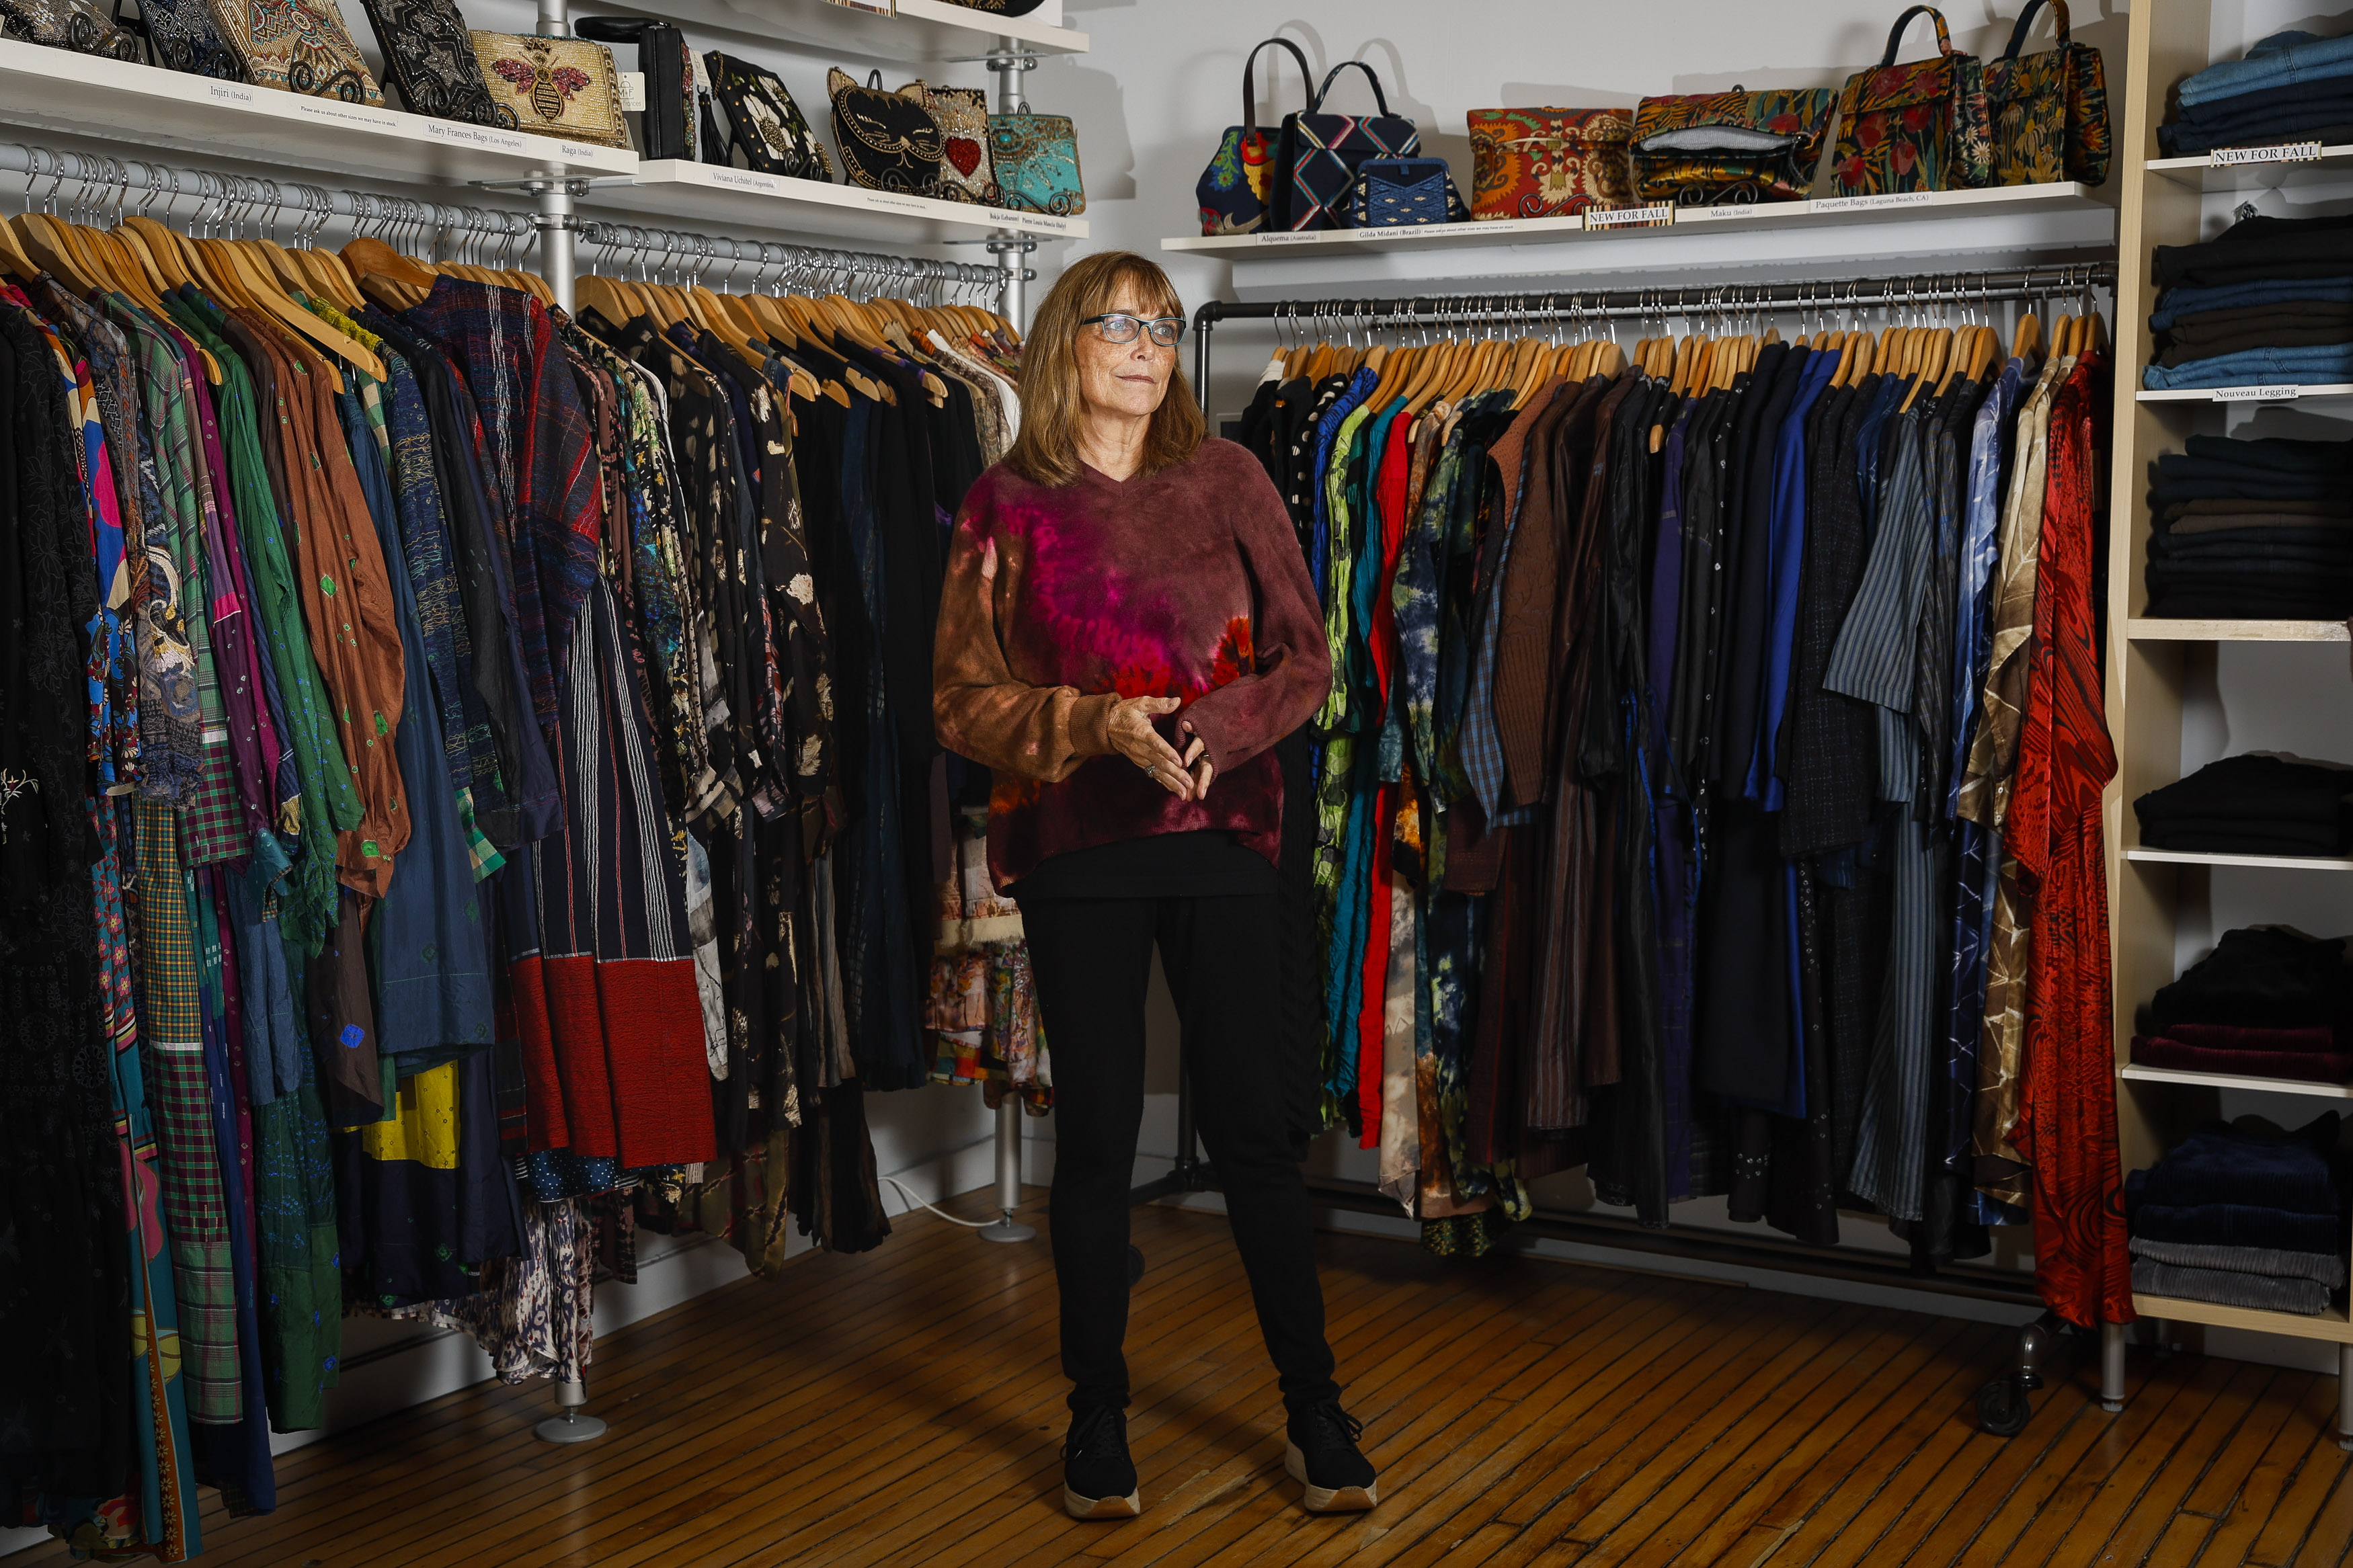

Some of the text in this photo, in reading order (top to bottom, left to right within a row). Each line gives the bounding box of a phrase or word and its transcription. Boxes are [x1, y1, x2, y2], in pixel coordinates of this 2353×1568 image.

[211, 86, 251, 102] Injiri (India)
[428, 124, 445, 137] Mary
[447, 127, 472, 139] Frances
[473, 131, 488, 144] Bags
[501, 138, 522, 148] Angeles)
[562, 145, 593, 157] Raga (India)
[2216, 146, 2316, 162] NEW FOR FALL
[713, 173, 733, 182] Viviana
[734, 175, 752, 185] Uchitel
[1816, 200, 1848, 210] Paquette
[1850, 199, 1868, 208] Bags
[1590, 209, 1667, 223] NEW FOR FALL
[1261, 235, 1289, 244] Alquema
[2259, 387, 2296, 398] Legging
